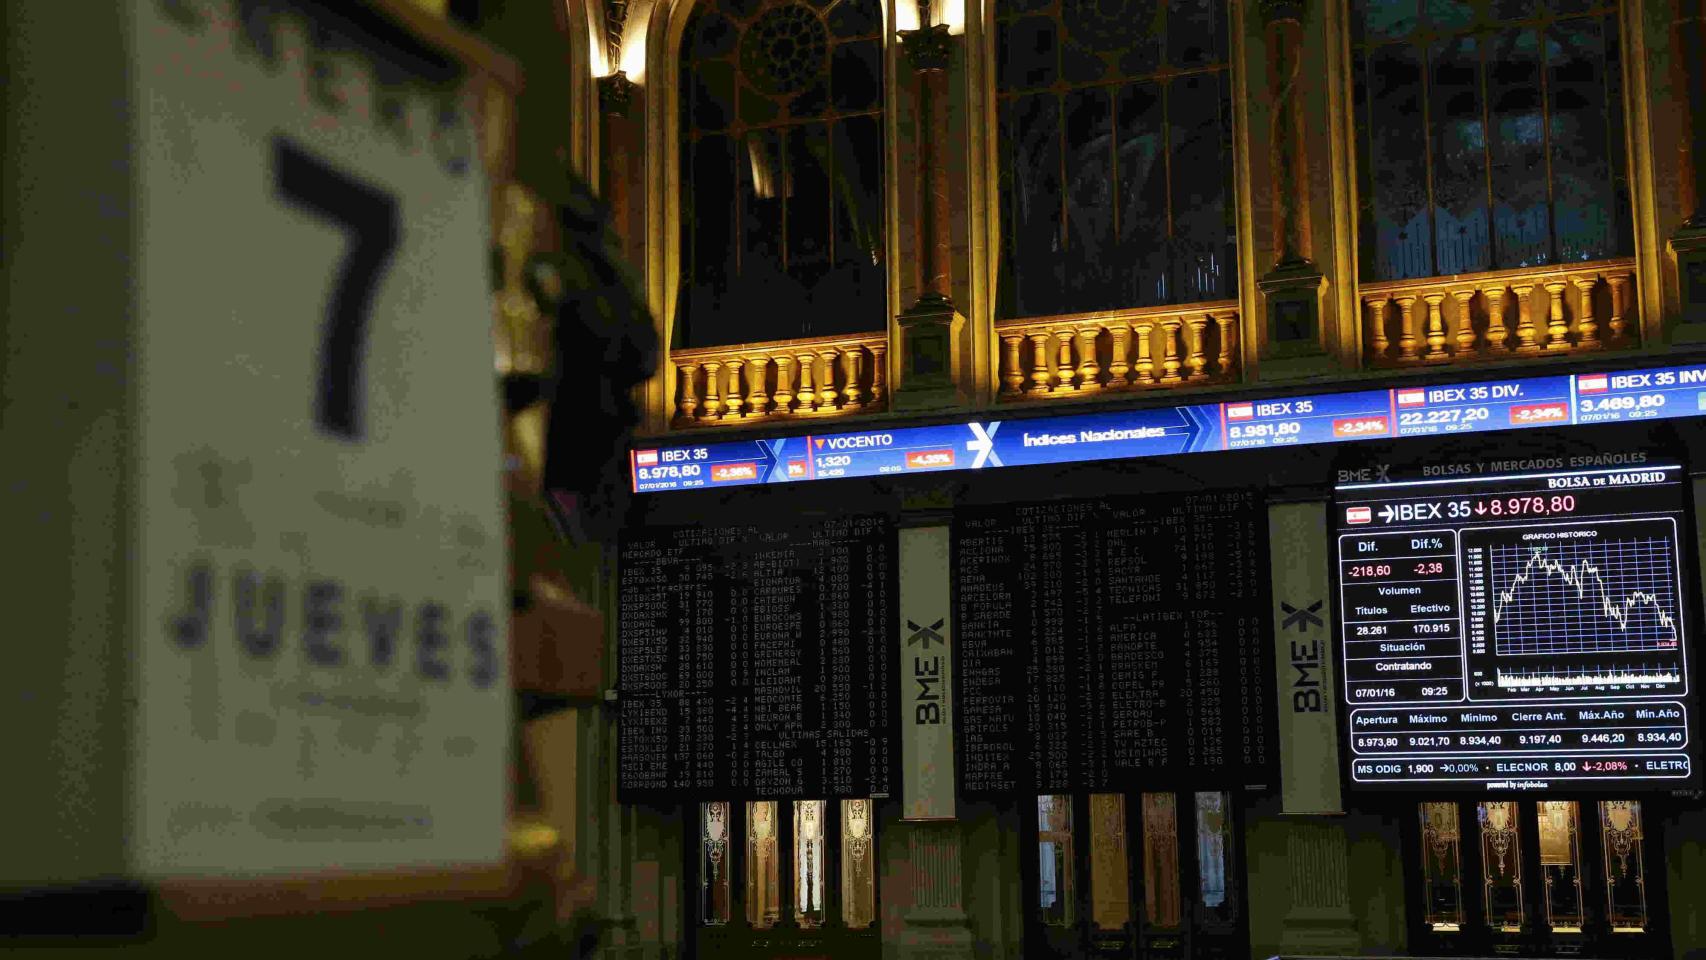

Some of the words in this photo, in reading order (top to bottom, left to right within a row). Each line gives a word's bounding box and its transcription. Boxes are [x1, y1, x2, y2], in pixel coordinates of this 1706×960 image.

[268, 132, 403, 444] 7
[1611, 374, 1651, 389] IBEX
[1655, 372, 1675, 385] 35
[1428, 389, 1466, 403] IBEX
[1470, 387, 1488, 399] 35
[1492, 384, 1524, 398] DIV.
[1257, 403, 1292, 416] IBEX
[1295, 401, 1313, 413] 35
[1580, 394, 1666, 412] 3.469,80
[1400, 407, 1489, 425] 22.227,20
[1515, 408, 1563, 420] -2,34%
[1230, 422, 1300, 438] 8.981,80
[1337, 421, 1384, 433] -2,34%
[828, 434, 893, 449] VOCENTO
[1023, 432, 1077, 447] Índices
[1080, 427, 1166, 443] Nacionales
[662, 450, 690, 462] IBEX
[693, 448, 708, 459] 35
[816, 456, 851, 467] 1,320
[1423, 463, 1472, 477] BOLSAS
[1476, 463, 1485, 473] Y
[1490, 457, 1564, 472] MERCADOS
[1570, 452, 1649, 467] ESPAÑOLES
[638, 465, 701, 479] 8.978,80
[1338, 469, 1371, 482] BME
[1548, 476, 1591, 488] BOLSA
[1609, 472, 1666, 485] MADRID
[1394, 503, 1442, 521] IBEX
[1448, 501, 1471, 518] 35
[1490, 495, 1575, 516] 8.978,80
[1358, 541, 1379, 552] Dif.
[1411, 538, 1443, 550] Dif.%
[1348, 565, 1391, 577] -218,60
[1413, 563, 1443, 575] -2,38
[1378, 586, 1422, 595] Volumen
[1410, 604, 1451, 613] Efectivo
[163, 558, 498, 690] JUEVES
[1413, 623, 1451, 634] 170.915
[1356, 626, 1388, 636] 28.261
[1380, 642, 1426, 652] Situación
[1375, 661, 1432, 671] Contratando
[1291, 640, 1321, 713] BME
[914, 656, 940, 725] BME
[1355, 688, 1396, 698] 07/01/16
[1421, 686, 1448, 696] 09:25
[1356, 716, 1398, 726] Apertura
[1409, 713, 1448, 724] Máximo
[1511, 712, 1543, 721] Cierre
[1545, 712, 1567, 721] Ant.
[1579, 710, 1625, 720] Máx.Año
[1358, 737, 1398, 748] 8.973,80
[1409, 736, 1450, 747] 9.021,70
[1460, 735, 1502, 747] 8.934,40
[1519, 734, 1562, 745] 9.197,40
[1581, 733, 1626, 744] 9.446,20
[1637, 732, 1682, 743] 8.934,40
[1357, 765, 1373, 774] MS
[1375, 764, 1402, 774] ODIG
[1408, 764, 1434, 775] 1,900
[1449, 763, 1479, 774] 0,00%
[1496, 763, 1549, 773] ELECNOR
[1554, 762, 1577, 772] 8,00
[1592, 761, 1628, 771] -2,08%
[1487, 780, 1508, 790] powered
[1510, 780, 1517, 790] by
